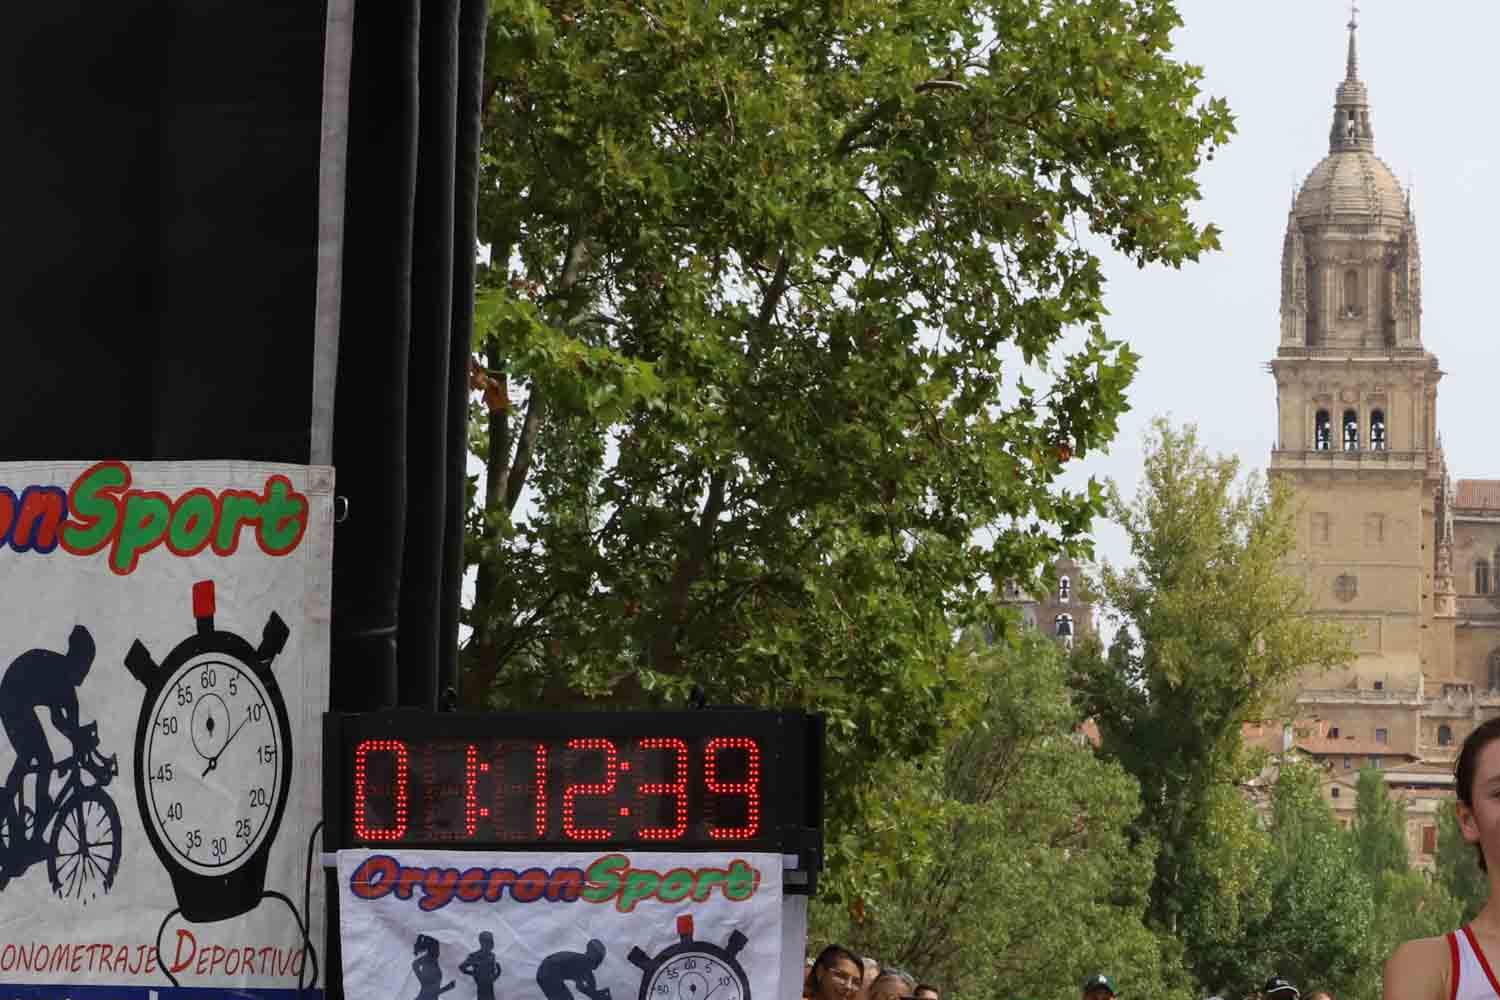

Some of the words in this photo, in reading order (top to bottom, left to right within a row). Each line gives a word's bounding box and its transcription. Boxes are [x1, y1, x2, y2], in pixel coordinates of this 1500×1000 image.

[200, 669, 216, 688] 60
[229, 677, 238, 697] 5
[177, 686, 193, 707] 55
[247, 704, 262, 723] 10
[162, 717, 178, 735] 50
[256, 744, 273, 764] 15
[156, 764, 173, 782] 45
[249, 788, 266, 808] 20
[354, 736, 760, 841] 01:12:39
[167, 803, 183, 821] 40
[235, 820, 251, 838] 25
[186, 830, 202, 848] 35
[211, 837, 227, 856] 30
